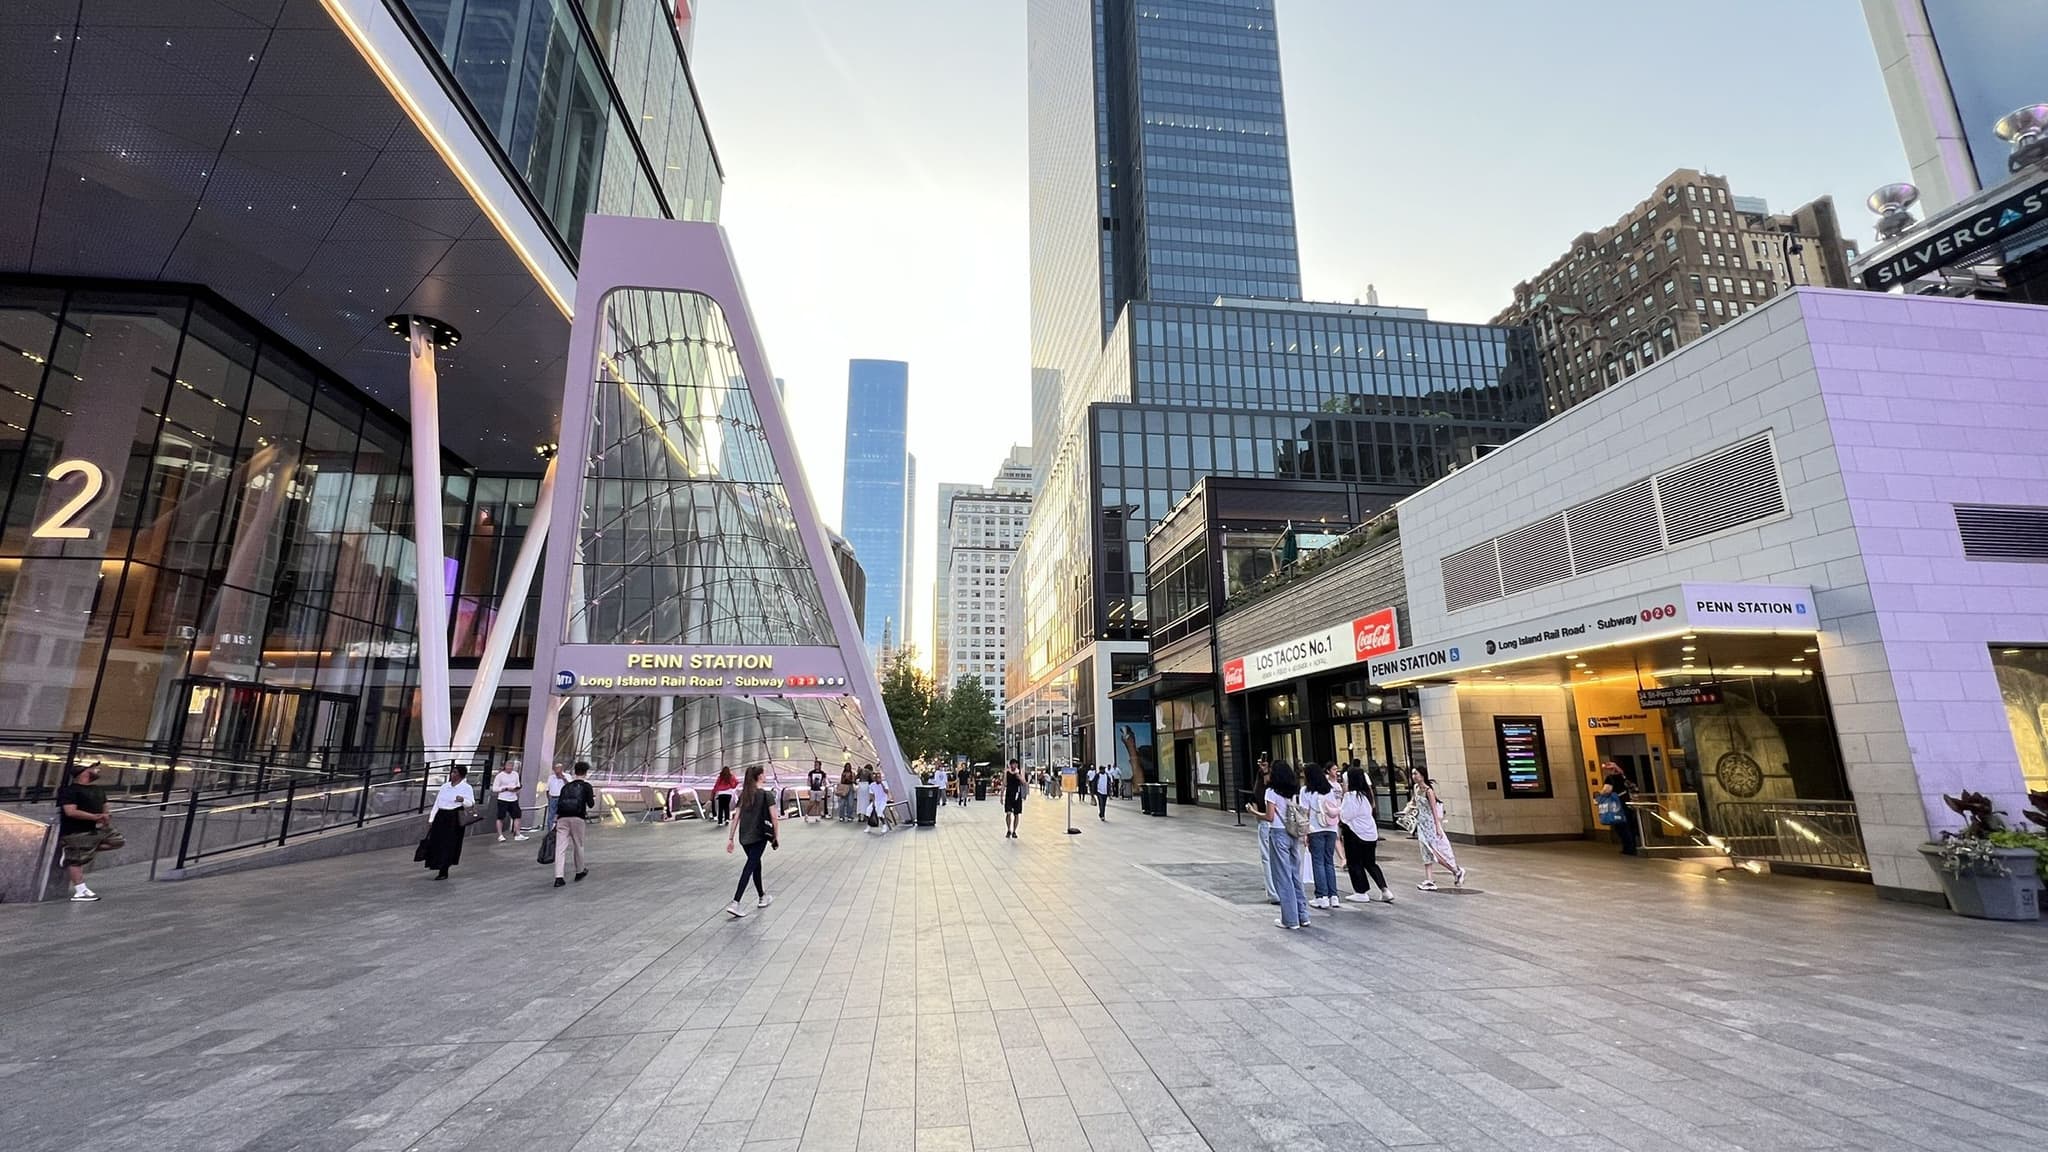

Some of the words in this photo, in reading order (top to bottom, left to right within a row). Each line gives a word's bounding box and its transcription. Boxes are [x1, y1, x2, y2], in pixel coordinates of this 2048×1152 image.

[32, 459, 103, 538] 2
[1697, 602, 1733, 613] PENN
[1738, 602, 1792, 614] STATION
[1498, 640, 1518, 650] Long
[1519, 633, 1542, 645] Island
[1543, 629, 1560, 641] Rail
[1561, 624, 1585, 637] Road
[1597, 615, 1637, 630] Subway
[628, 654, 683, 668] PENN
[690, 654, 773, 669] STATION
[1256, 653, 1274, 671] LOS
[1274, 643, 1307, 665] TACOS
[1309, 634, 1332, 657] No.1
[1372, 660, 1399, 677] PENN
[1400, 650, 1447, 672] STATION
[580, 676, 613, 688] Long
[617, 676, 657, 686] Island
[661, 675, 686, 686] Rail
[690, 676, 723, 686] Road
[735, 676, 785, 688] Subway
